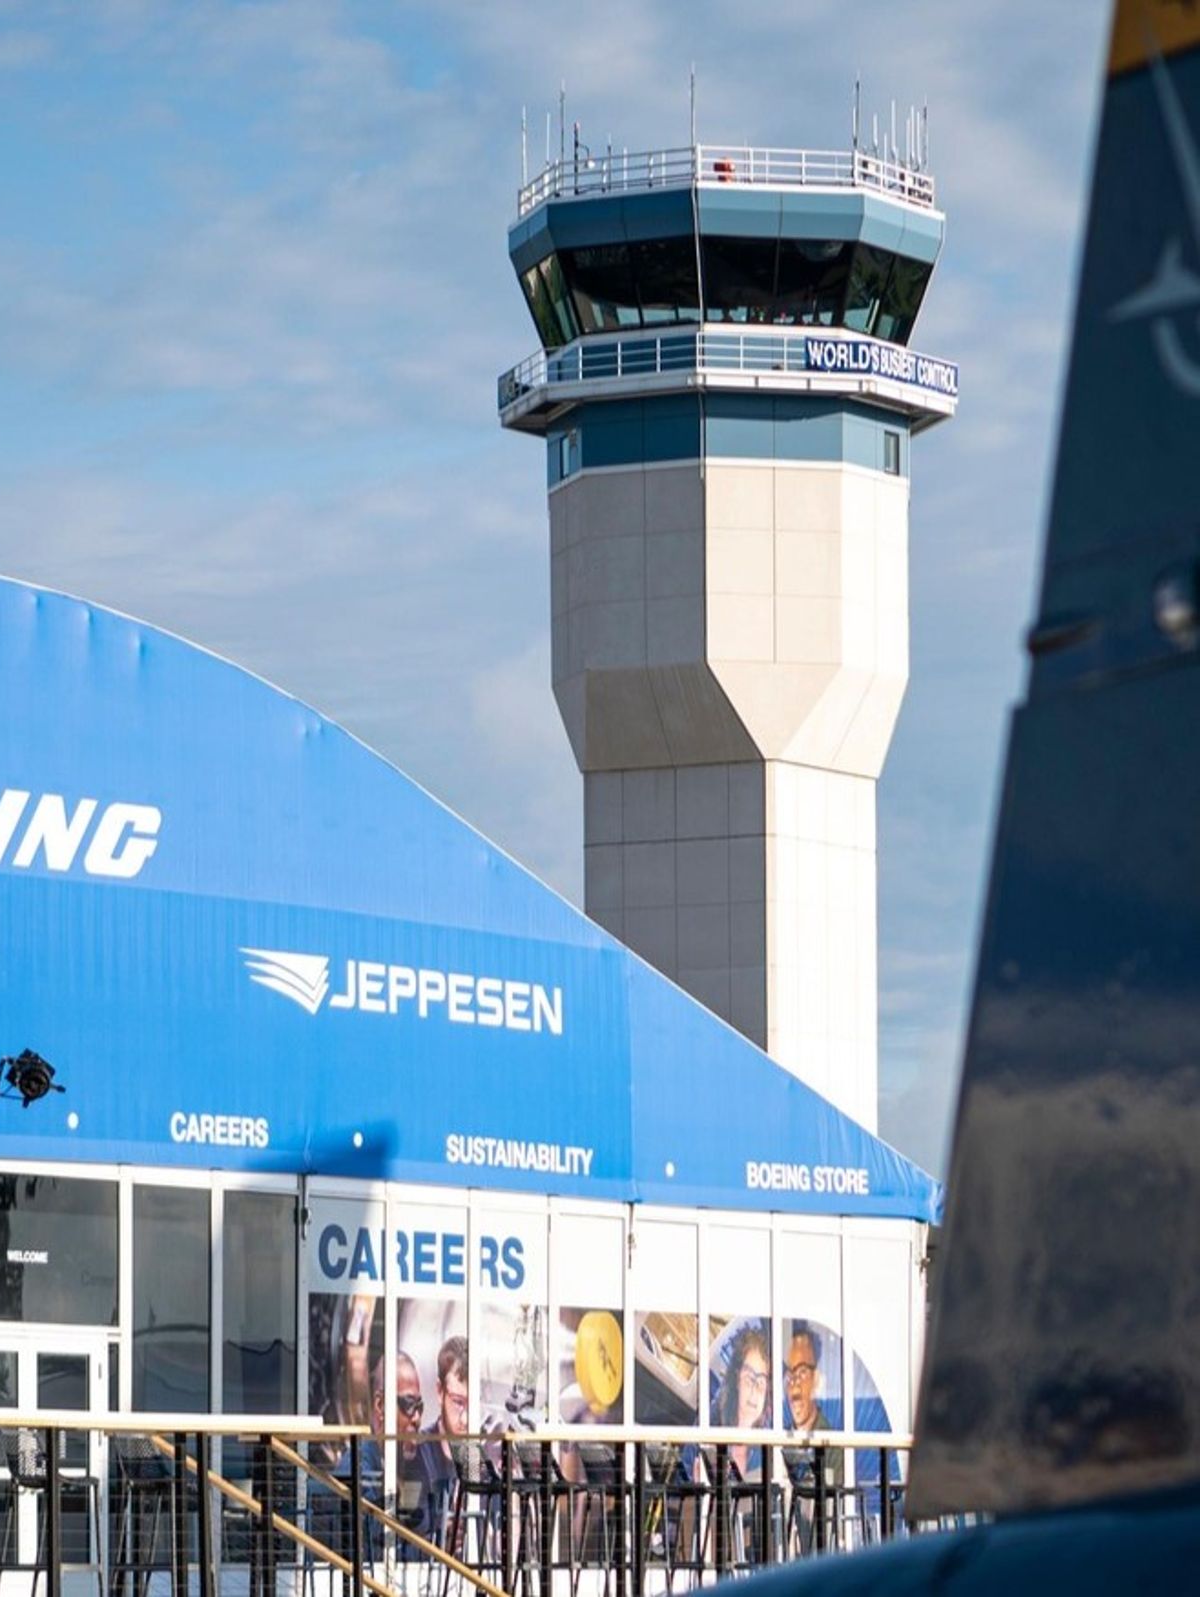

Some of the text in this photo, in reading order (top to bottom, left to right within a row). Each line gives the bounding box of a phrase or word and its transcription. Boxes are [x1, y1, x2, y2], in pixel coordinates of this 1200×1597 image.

[880, 345, 916, 382] BUSIEST
[917, 358, 958, 393] CONTROL
[329, 959, 563, 1035] JEPPESEN
[170, 1111, 269, 1148] CAREERS
[446, 1133, 594, 1176] SUSTAINABILITY
[746, 1161, 870, 1196] BOEING STORE
[318, 1223, 525, 1290] CAREERS
